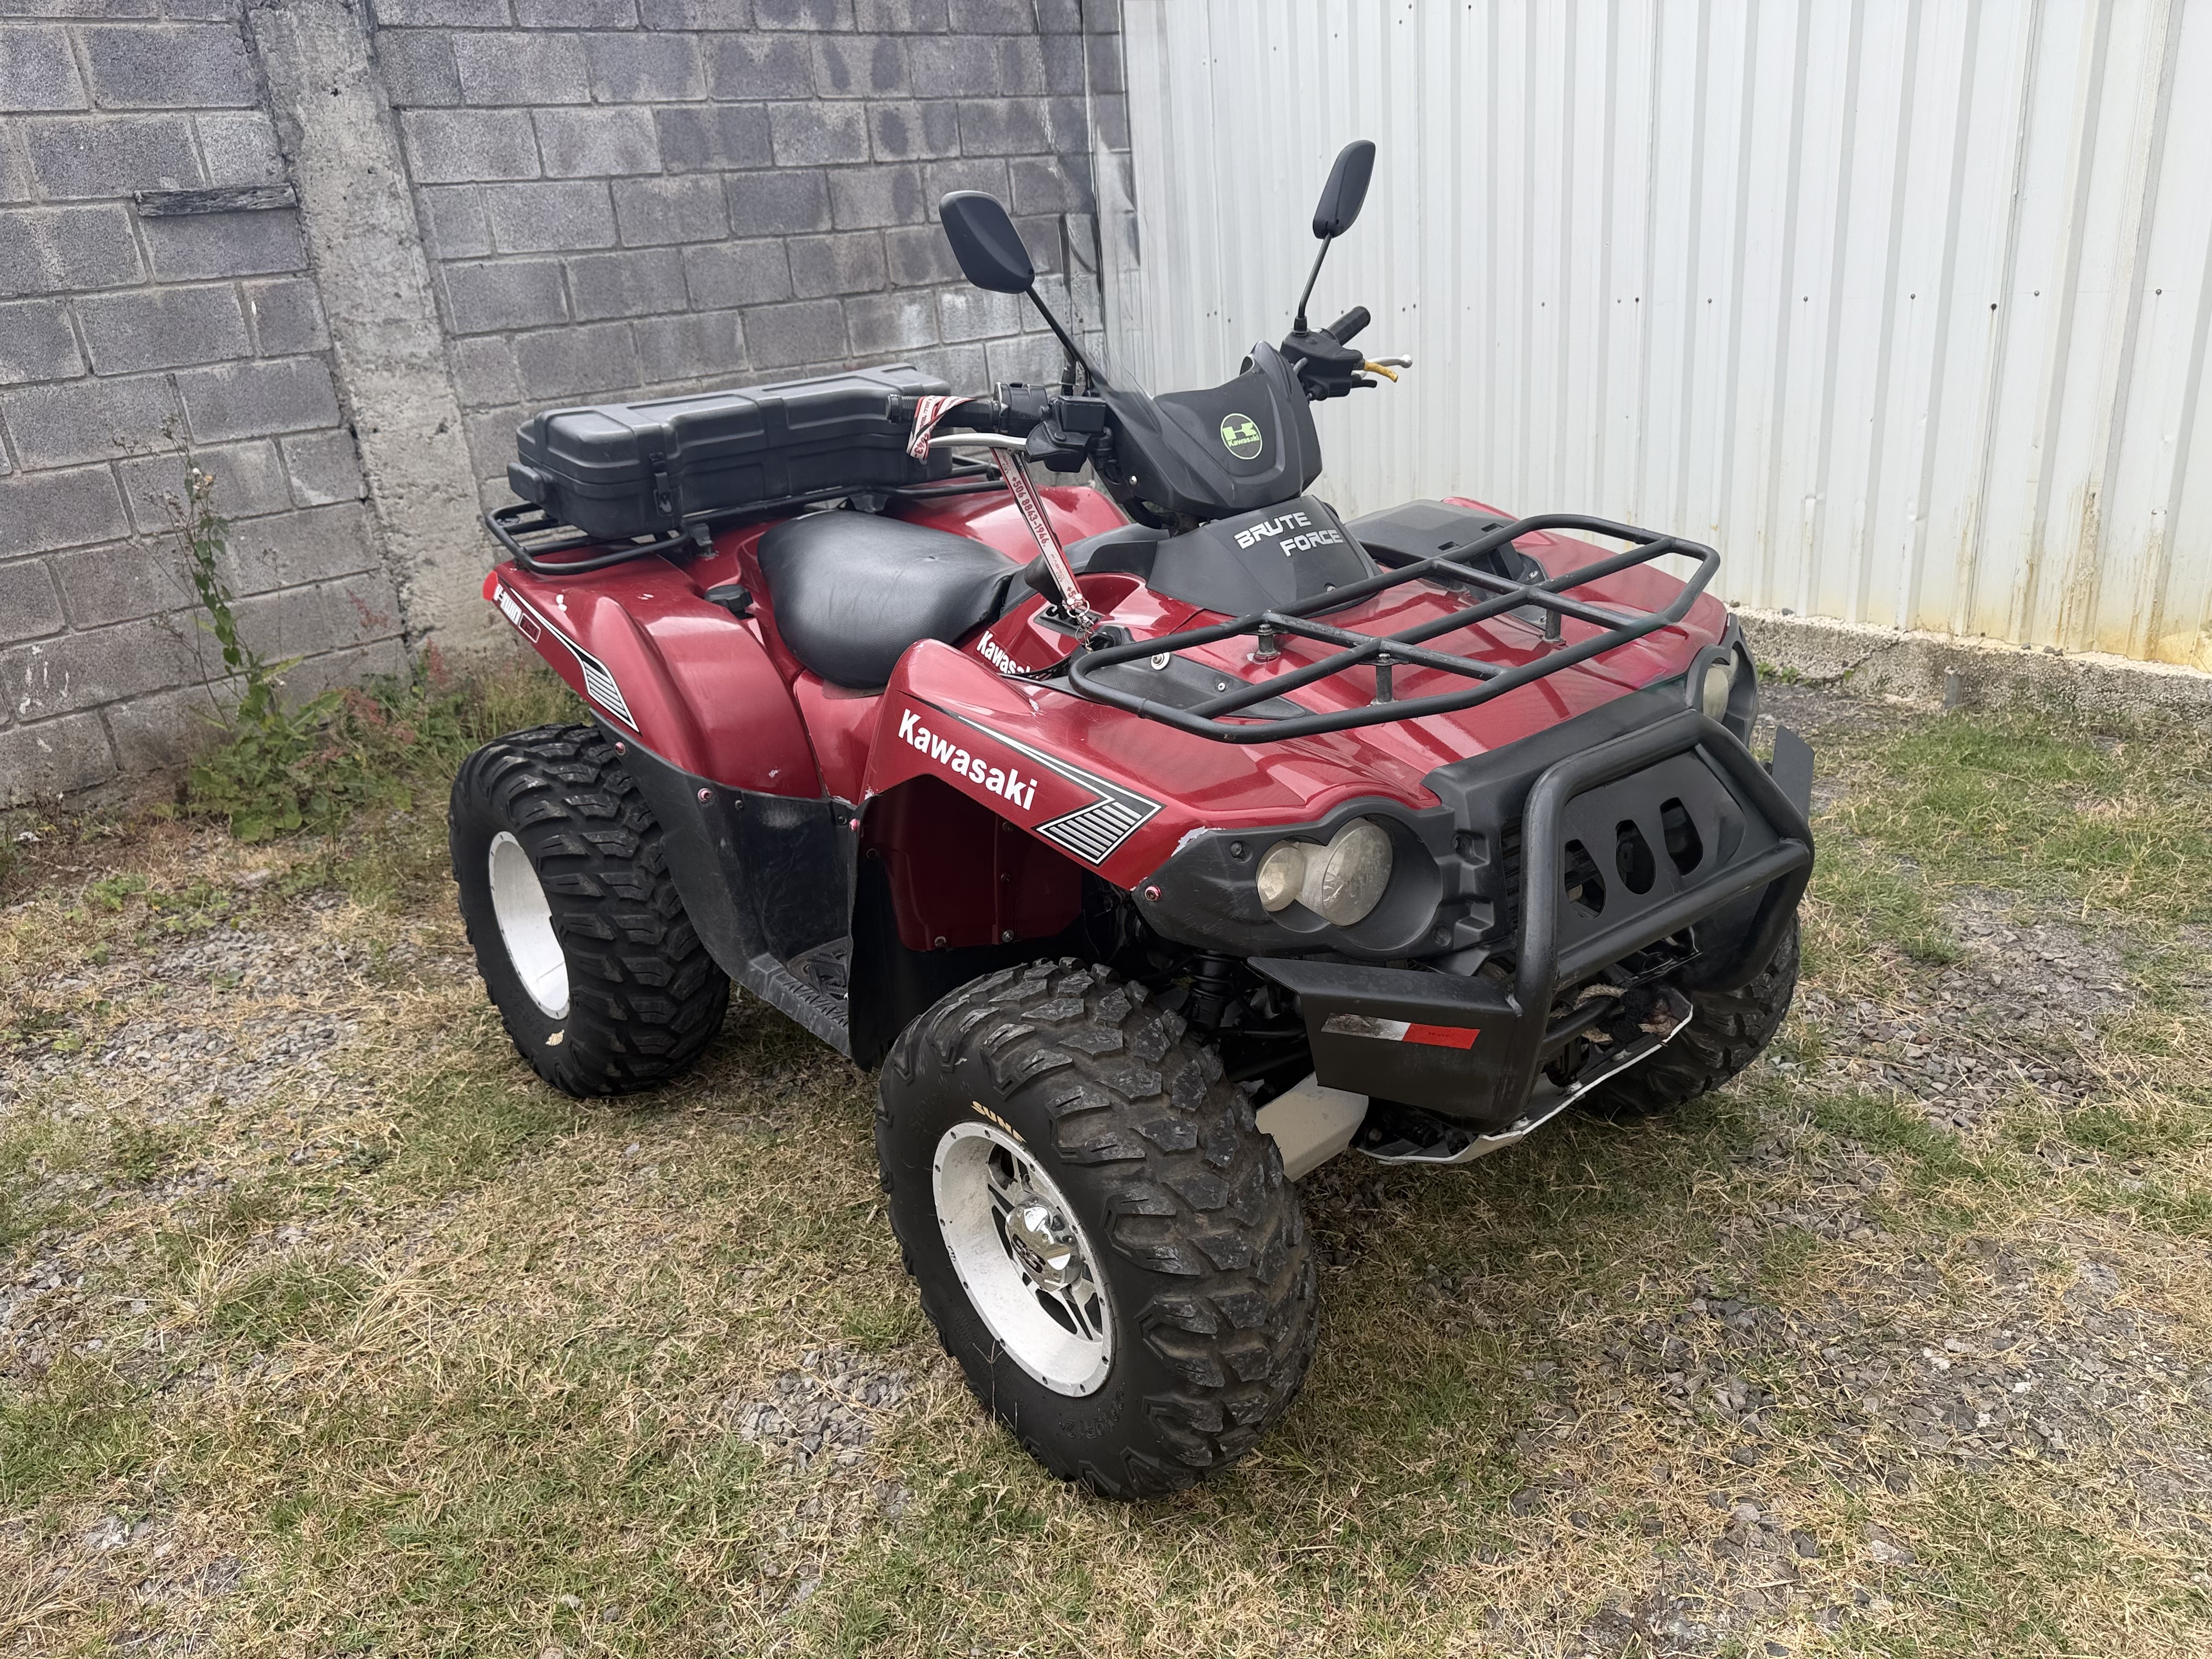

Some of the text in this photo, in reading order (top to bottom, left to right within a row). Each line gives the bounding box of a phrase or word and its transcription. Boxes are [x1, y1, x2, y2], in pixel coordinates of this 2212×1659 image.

[1227, 434, 1260, 447] Kawasaki
[1012, 476, 1026, 498] +506
[1234, 512, 1312, 550] BRUTE
[1279, 529, 1344, 557] FORCE
[898, 708, 1039, 811] Kawasaki
